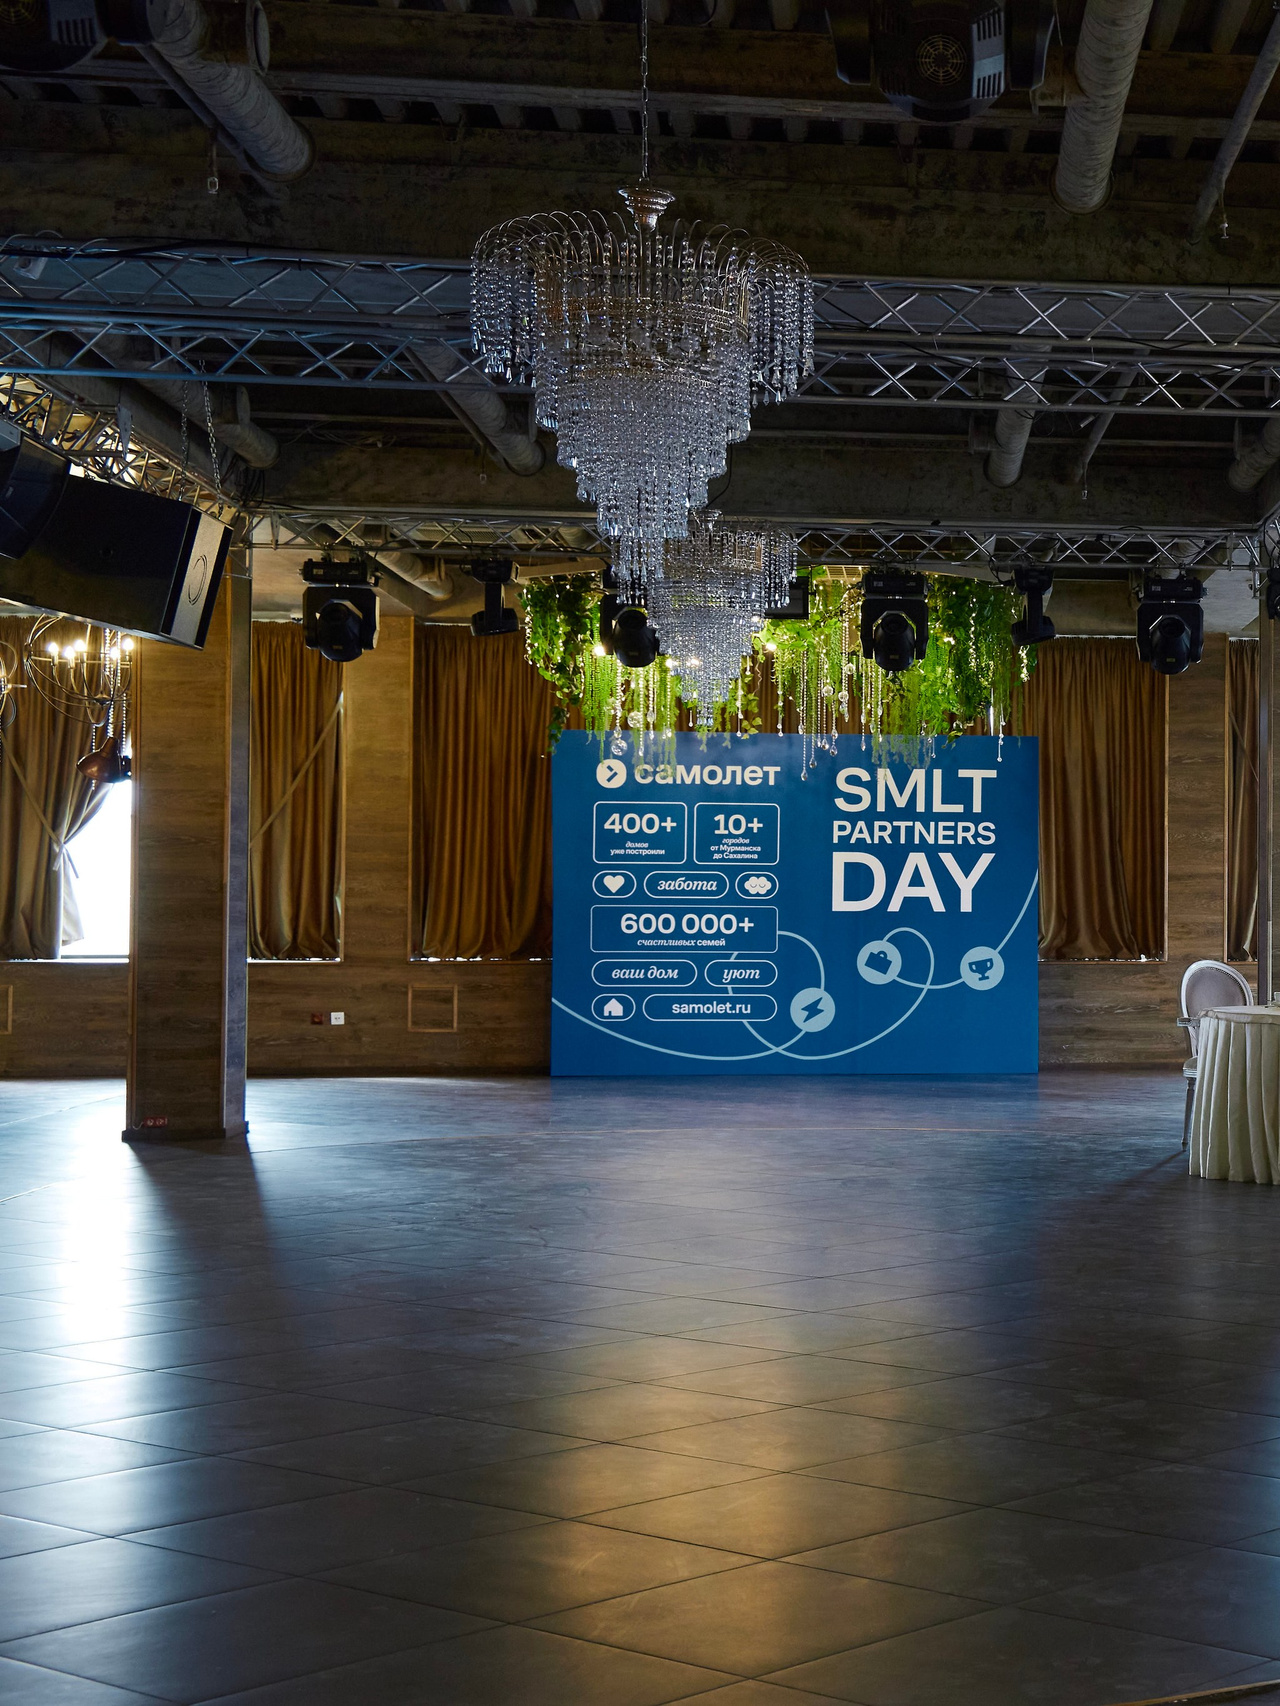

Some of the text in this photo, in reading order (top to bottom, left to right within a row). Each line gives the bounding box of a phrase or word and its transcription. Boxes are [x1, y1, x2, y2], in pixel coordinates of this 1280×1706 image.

[634, 764, 781, 786] самолет
[834, 767, 997, 813] SMLT
[603, 812, 677, 834] 400+
[713, 814, 764, 835] 10+
[833, 820, 996, 846] PARTNERS
[720, 844, 762, 852] Мурманска
[721, 837, 750, 845] городов
[625, 848, 666, 856] построили
[723, 852, 759, 860] Сахалина
[657, 877, 718, 891] забота
[831, 852, 996, 913] DAY
[620, 913, 755, 934] 600 000+
[697, 938, 726, 946] семей
[611, 966, 679, 979] ваш дом
[722, 968, 760, 983] уют
[671, 1001, 751, 1014] samolet.ru
